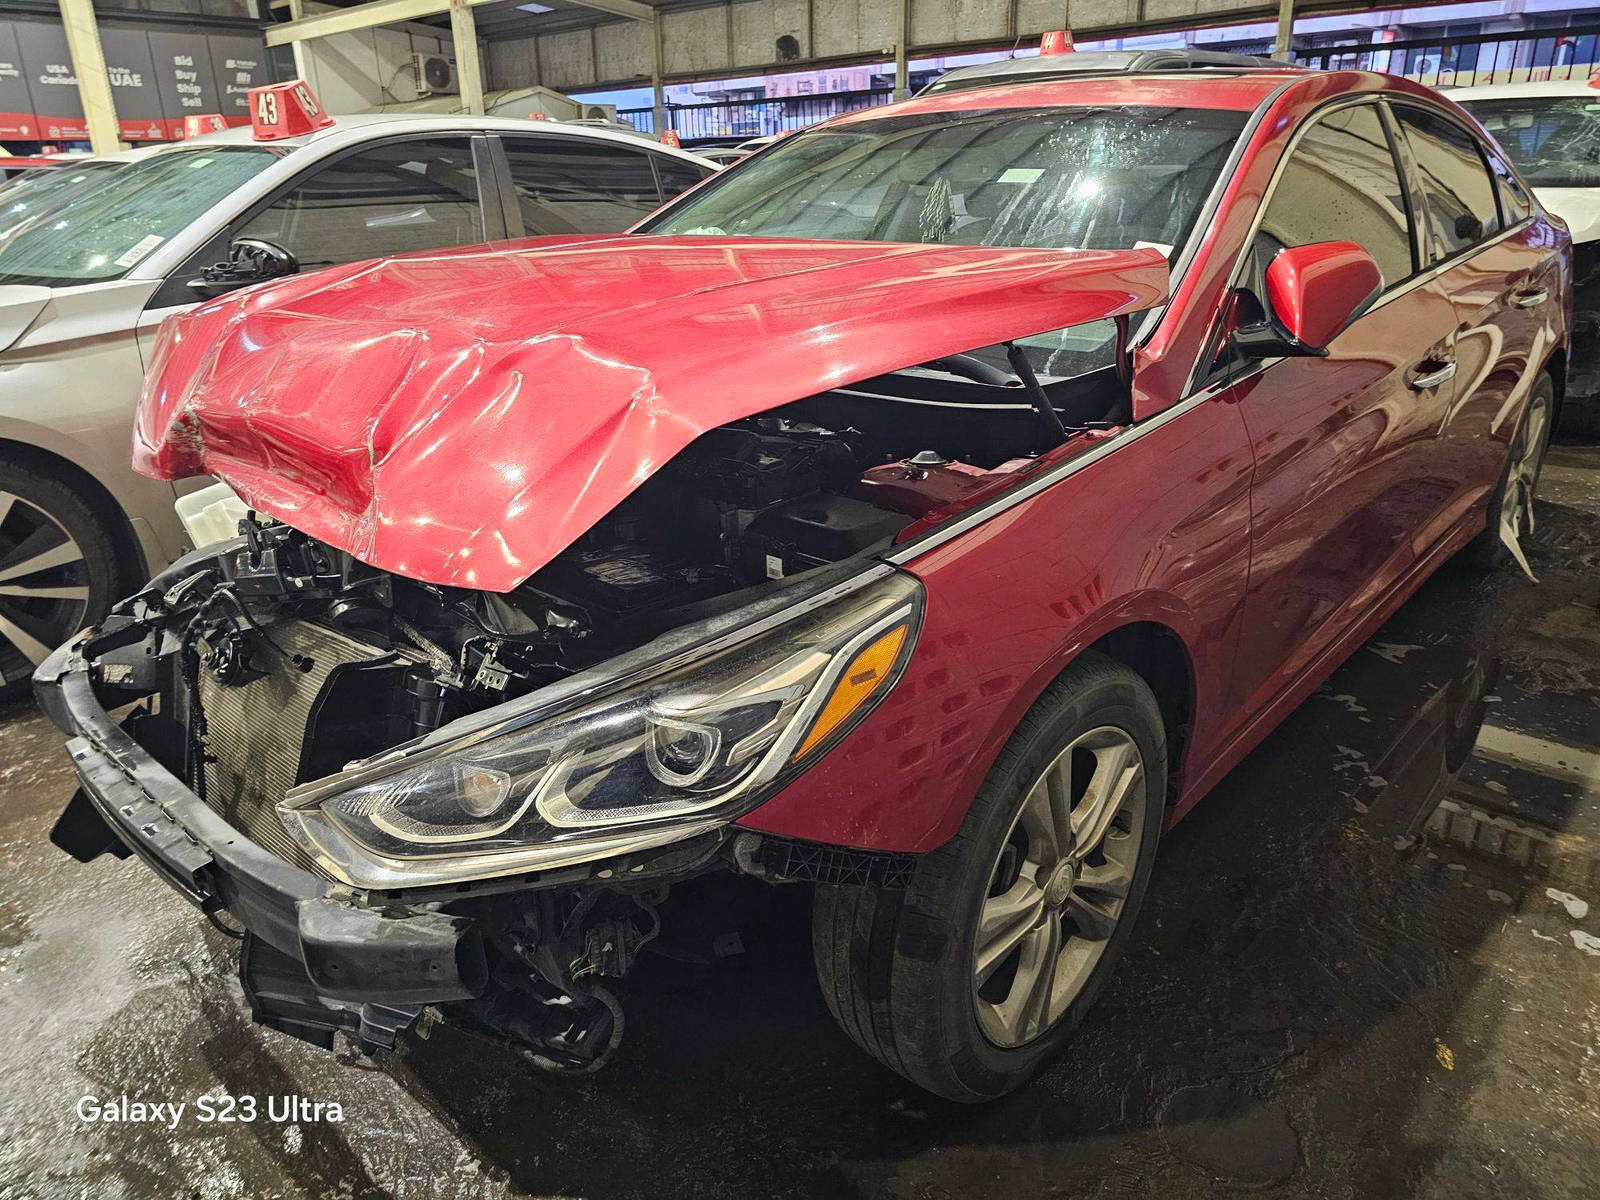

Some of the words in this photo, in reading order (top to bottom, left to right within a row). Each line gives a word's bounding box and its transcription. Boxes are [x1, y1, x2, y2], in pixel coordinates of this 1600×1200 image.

[174, 55, 193, 66] Bid
[45, 64, 70, 73] USA
[40, 74, 78, 85] Canad
[109, 74, 143, 87] UAE
[175, 69, 198, 82] Buy
[176, 83, 202, 96] Ship
[181, 97, 203, 107] Sell
[258, 93, 278, 125] 43
